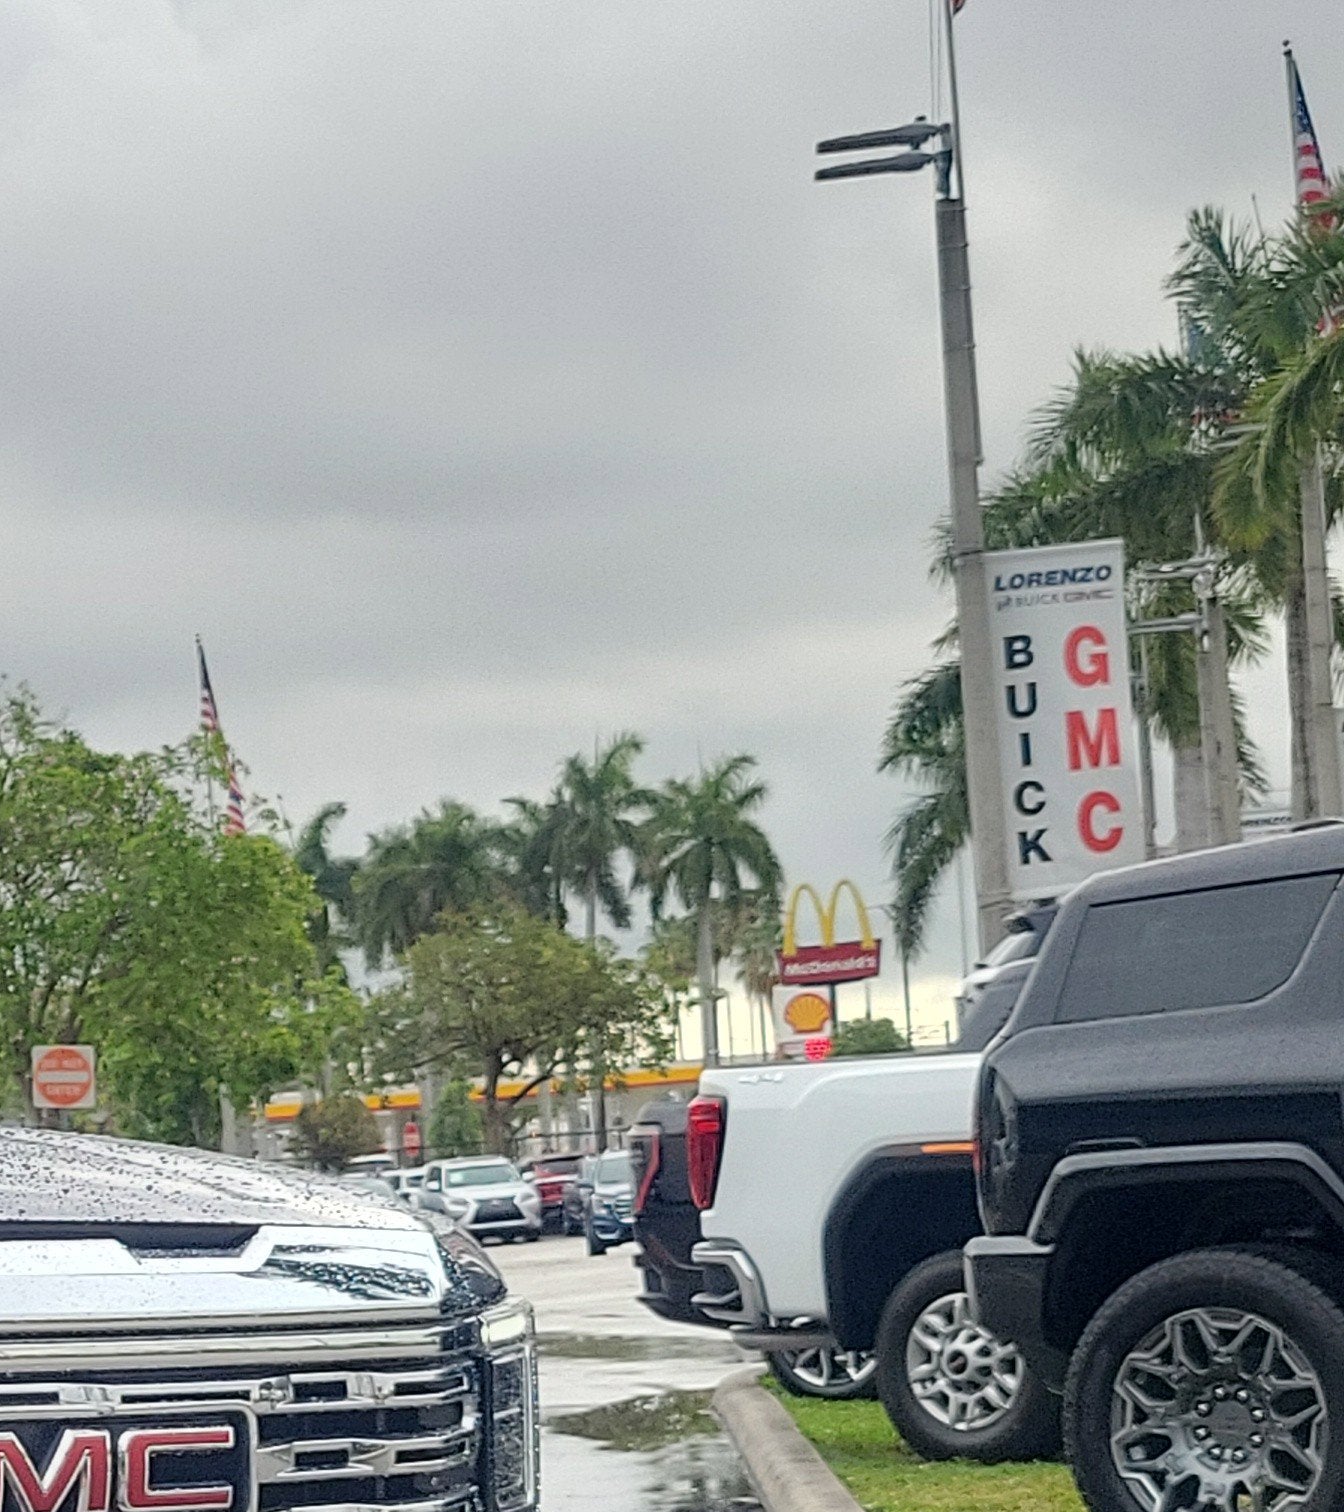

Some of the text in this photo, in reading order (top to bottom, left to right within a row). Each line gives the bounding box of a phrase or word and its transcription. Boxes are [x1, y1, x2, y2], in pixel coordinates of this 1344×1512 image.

[993, 565, 1112, 592] LORENZO
[1003, 634, 1053, 866] BUICK
[1063, 625, 1124, 854] GMC
